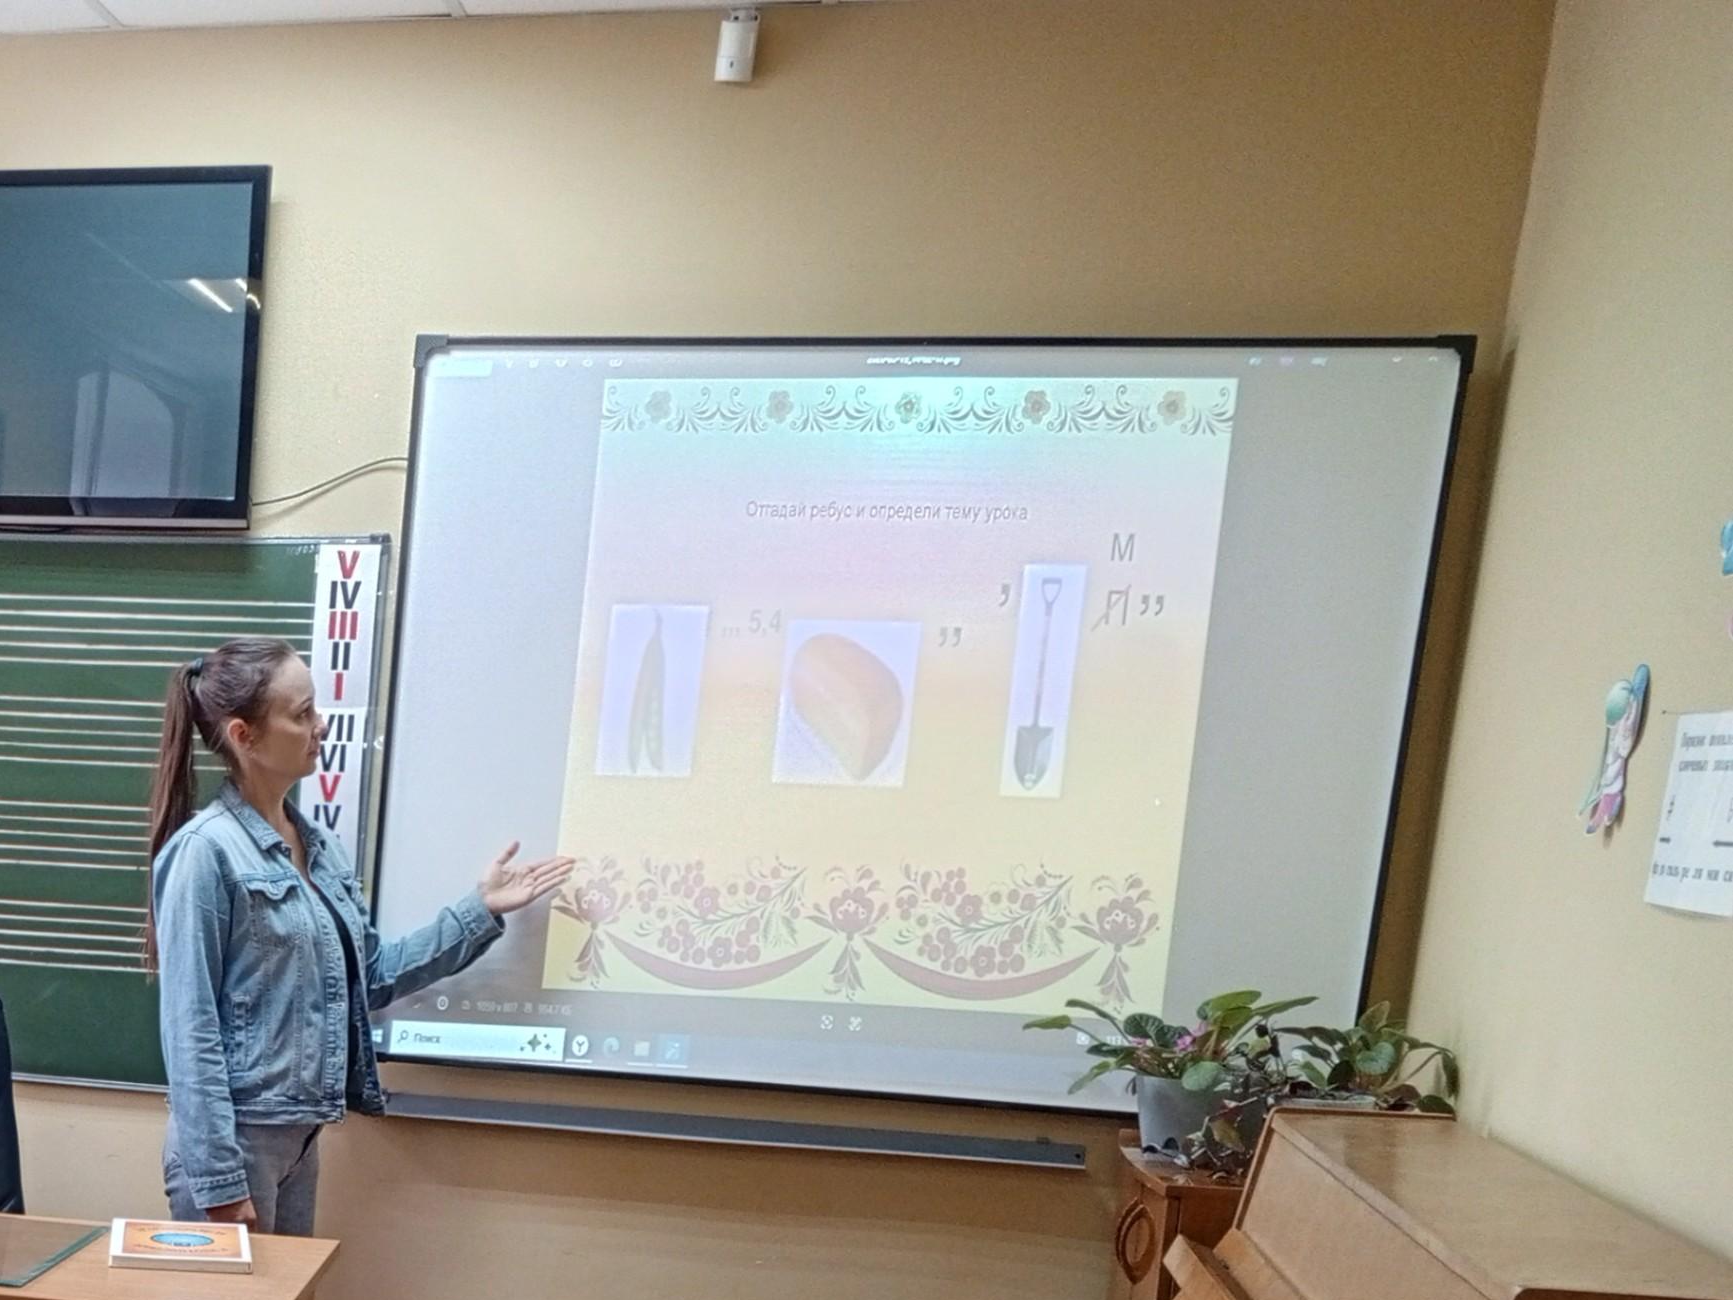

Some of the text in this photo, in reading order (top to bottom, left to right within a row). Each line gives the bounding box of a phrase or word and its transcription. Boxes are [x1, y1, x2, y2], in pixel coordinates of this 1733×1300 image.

[746, 500, 1028, 525] Отгадай ребус и определи тему урока
[337, 550, 361, 579] V
[329, 581, 362, 609] IV
[328, 611, 358, 640] III
[331, 642, 351, 671] II
[334, 673, 343, 701] I
[321, 714, 355, 742] VII
[320, 744, 346, 772] VI
[319, 774, 341, 803] V
